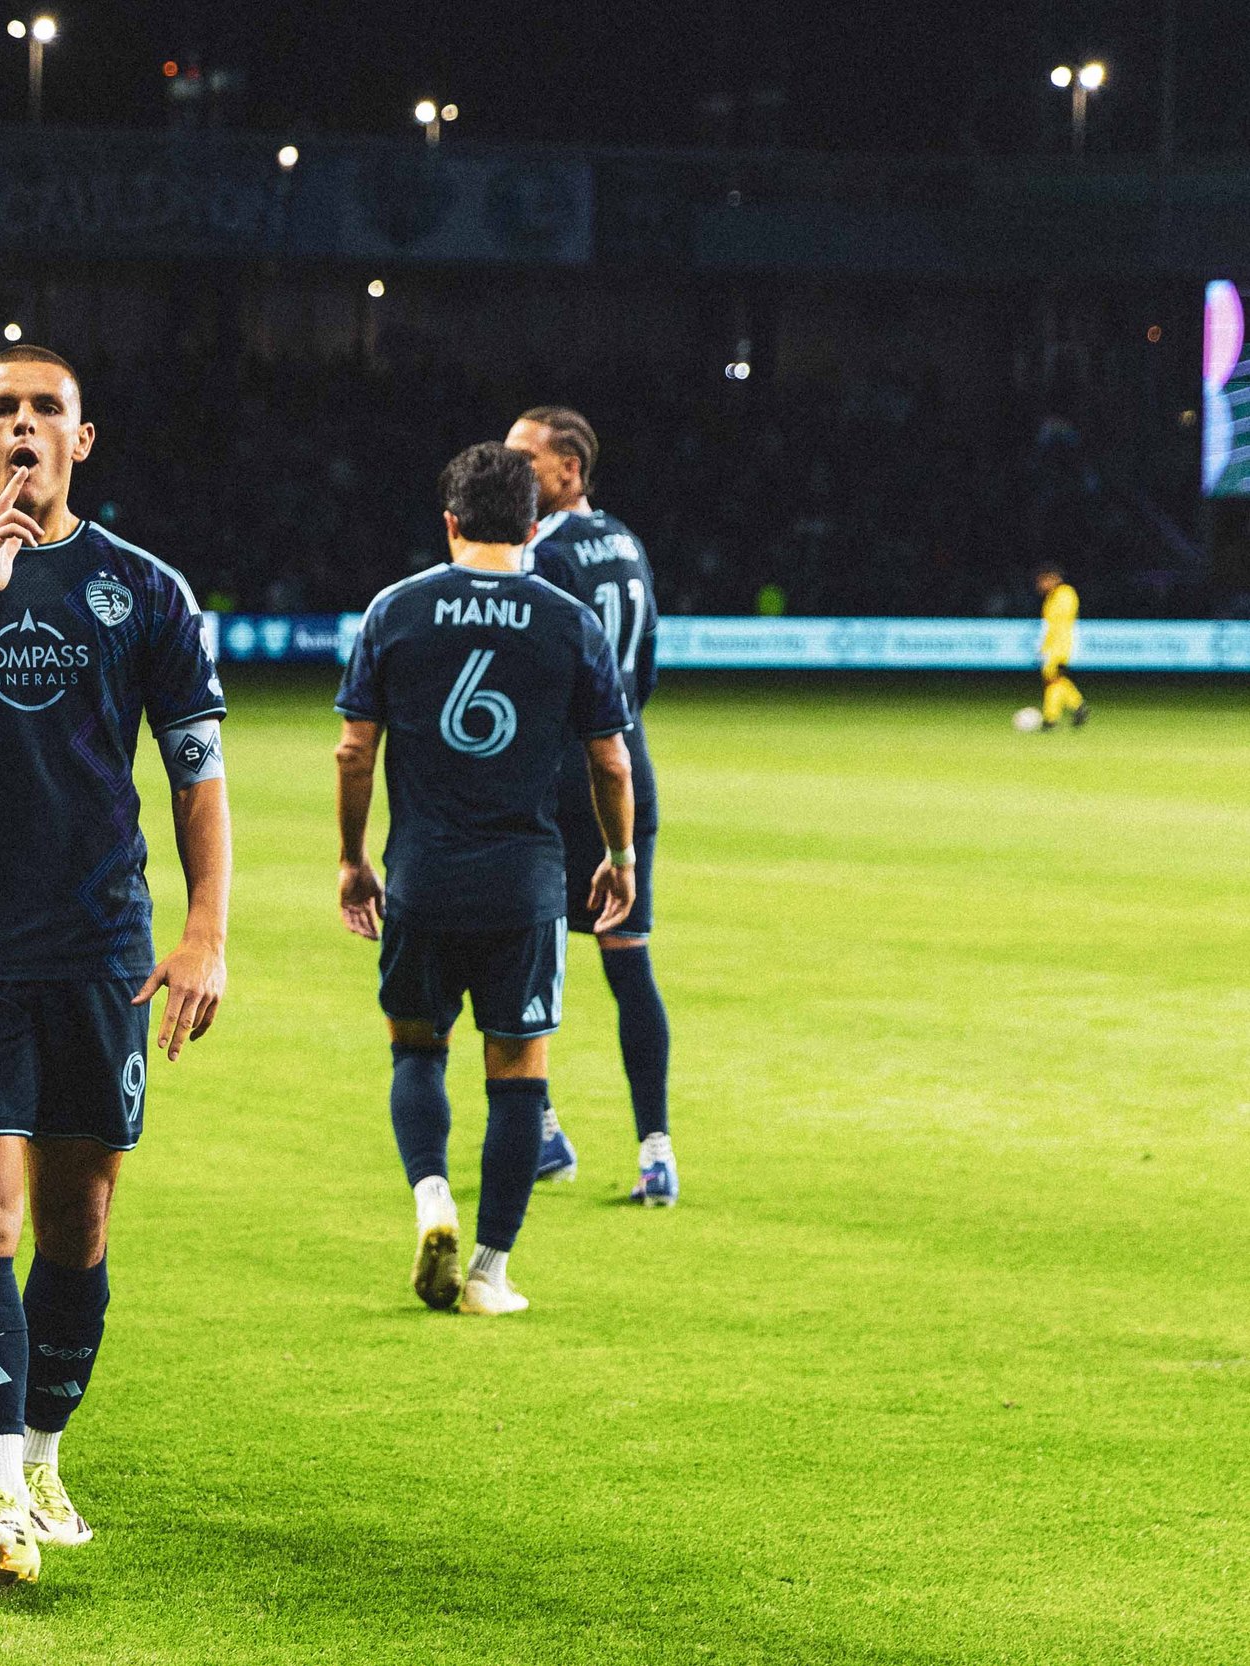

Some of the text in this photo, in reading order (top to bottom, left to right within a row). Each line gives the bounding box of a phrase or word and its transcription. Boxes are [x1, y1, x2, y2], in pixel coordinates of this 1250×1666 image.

[434, 597, 532, 630] MANU
[594, 578, 644, 673] 11
[439, 649, 518, 759] 6
[185, 746, 200, 761] S
[122, 1051, 146, 1122] 9
